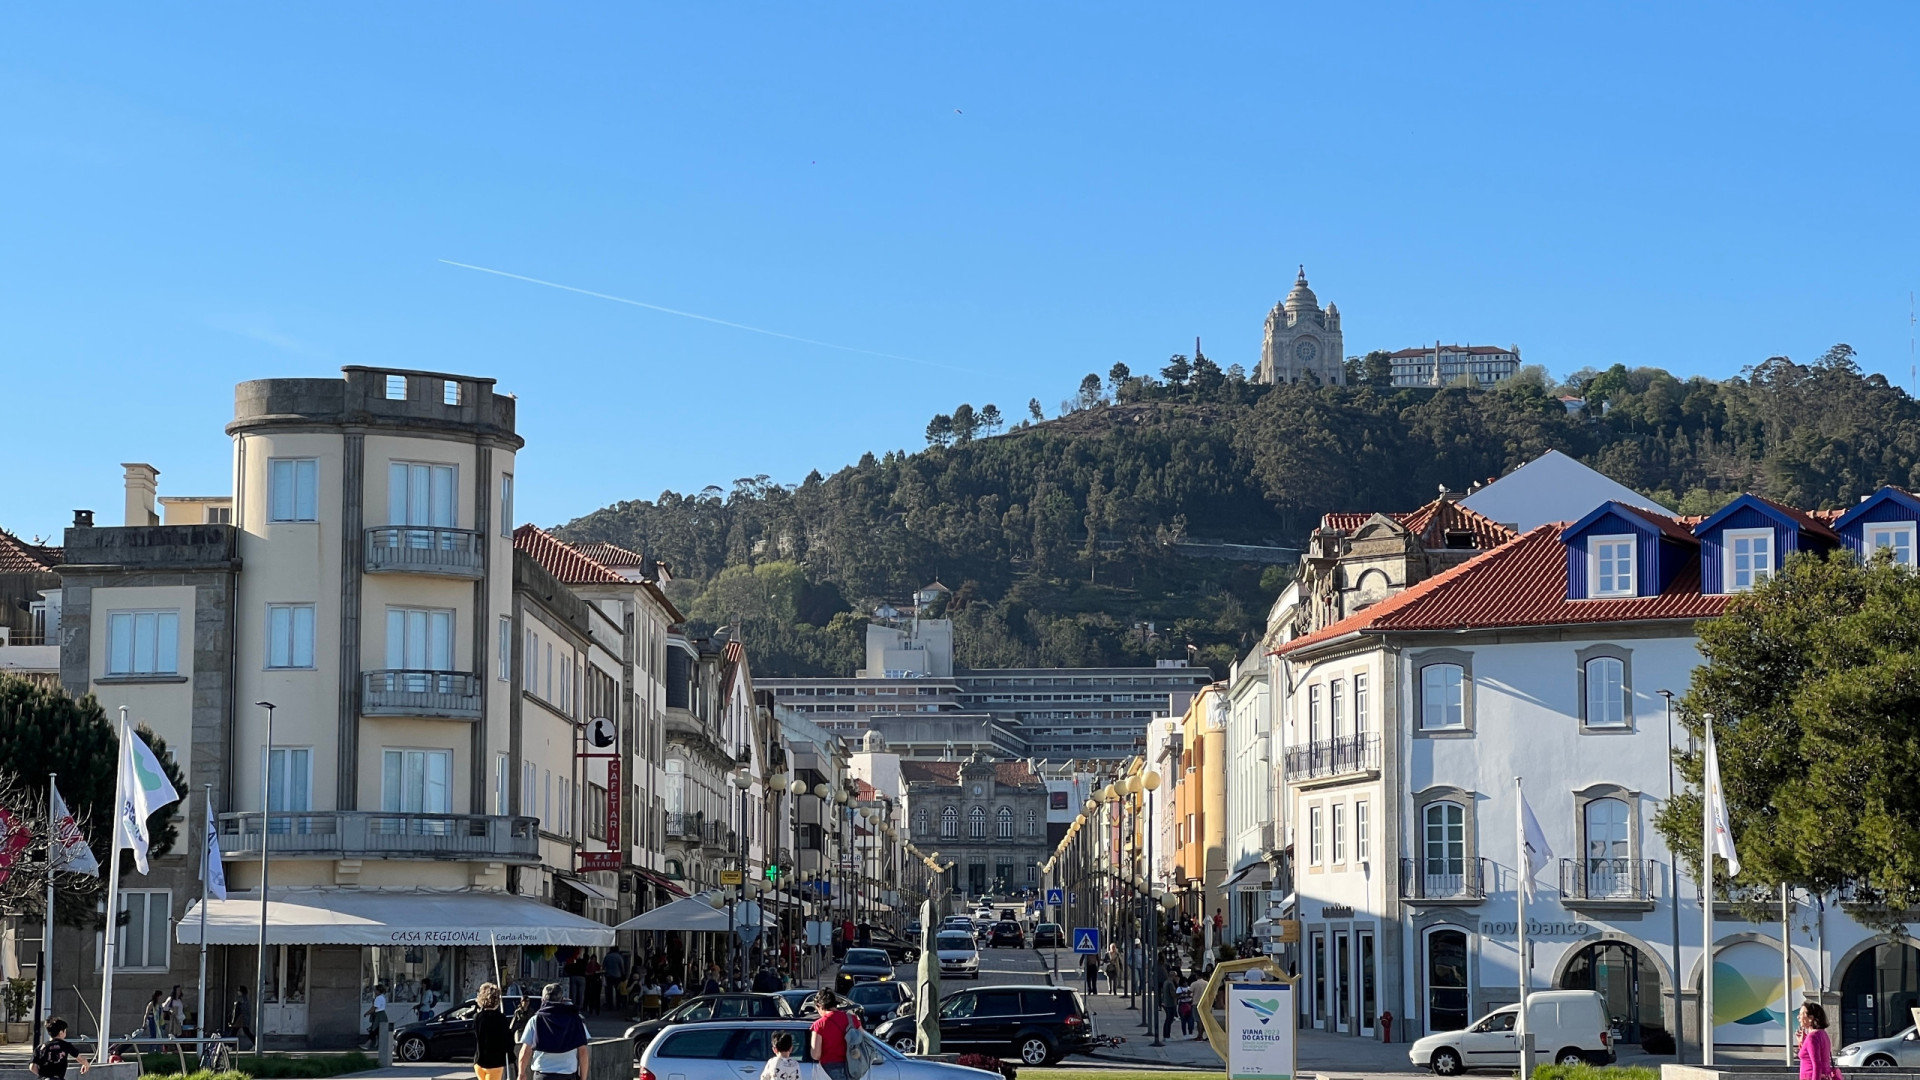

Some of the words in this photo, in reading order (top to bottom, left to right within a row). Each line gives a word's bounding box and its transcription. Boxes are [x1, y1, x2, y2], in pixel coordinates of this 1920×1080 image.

[610, 763, 618, 847] CAFETARIA
[391, 931, 421, 941] CASA
[424, 931, 481, 941] REGIONAL
[496, 932, 516, 941] Carla
[517, 932, 537, 941] Abreu
